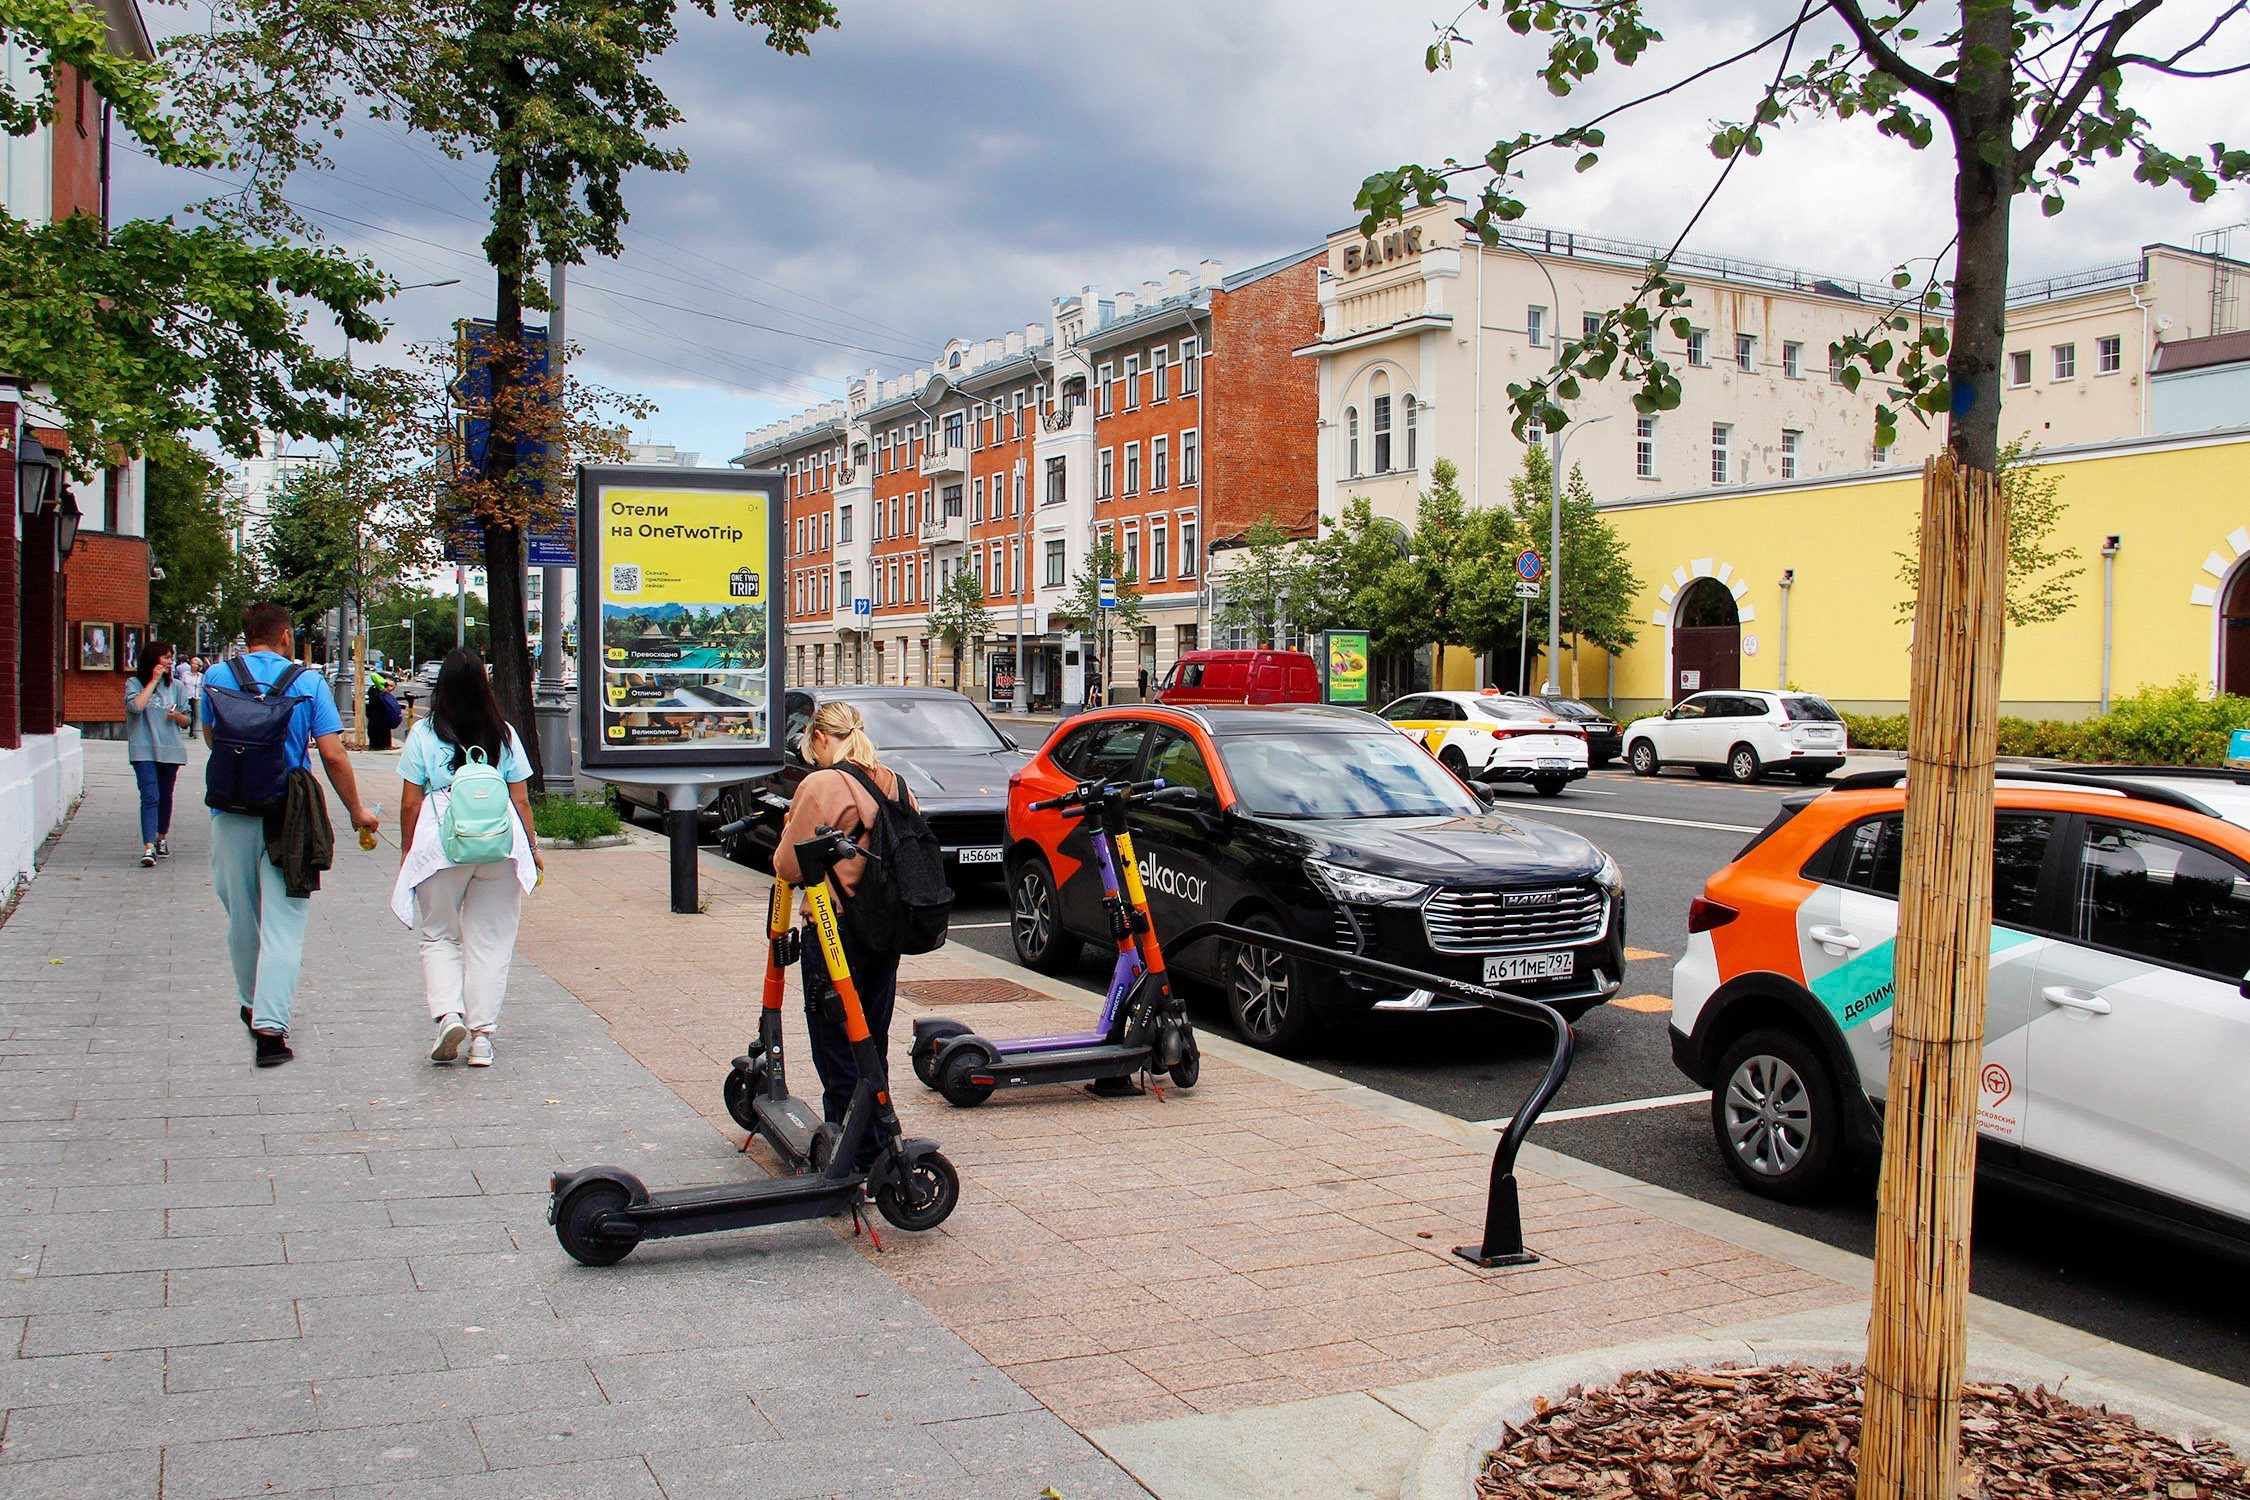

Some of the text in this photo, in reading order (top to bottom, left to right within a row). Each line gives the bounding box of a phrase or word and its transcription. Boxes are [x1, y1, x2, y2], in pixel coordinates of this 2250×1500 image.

[1343, 225, 1423, 272] БАНК
[611, 502, 669, 517] Отели
[611, 524, 743, 543] на OneTwoTrip
[731, 574, 758, 583] ONE TWO
[731, 582, 759, 596] TRIP!
[631, 651, 679, 659] Превосходно
[631, 689, 662, 697] Отлично
[631, 728, 679, 736] Великолепно
[1138, 851, 1207, 906] elkacar
[773, 880, 783, 925] WHOOSH
[1507, 893, 1553, 906] HAVAL
[815, 894, 837, 947] WHOOSH
[1488, 953, 1570, 979] А611МЕ 797
[1844, 982, 1896, 1022] делим
[1975, 1109, 2016, 1126] осковский
[1975, 1119, 2013, 1135] ршеринг
